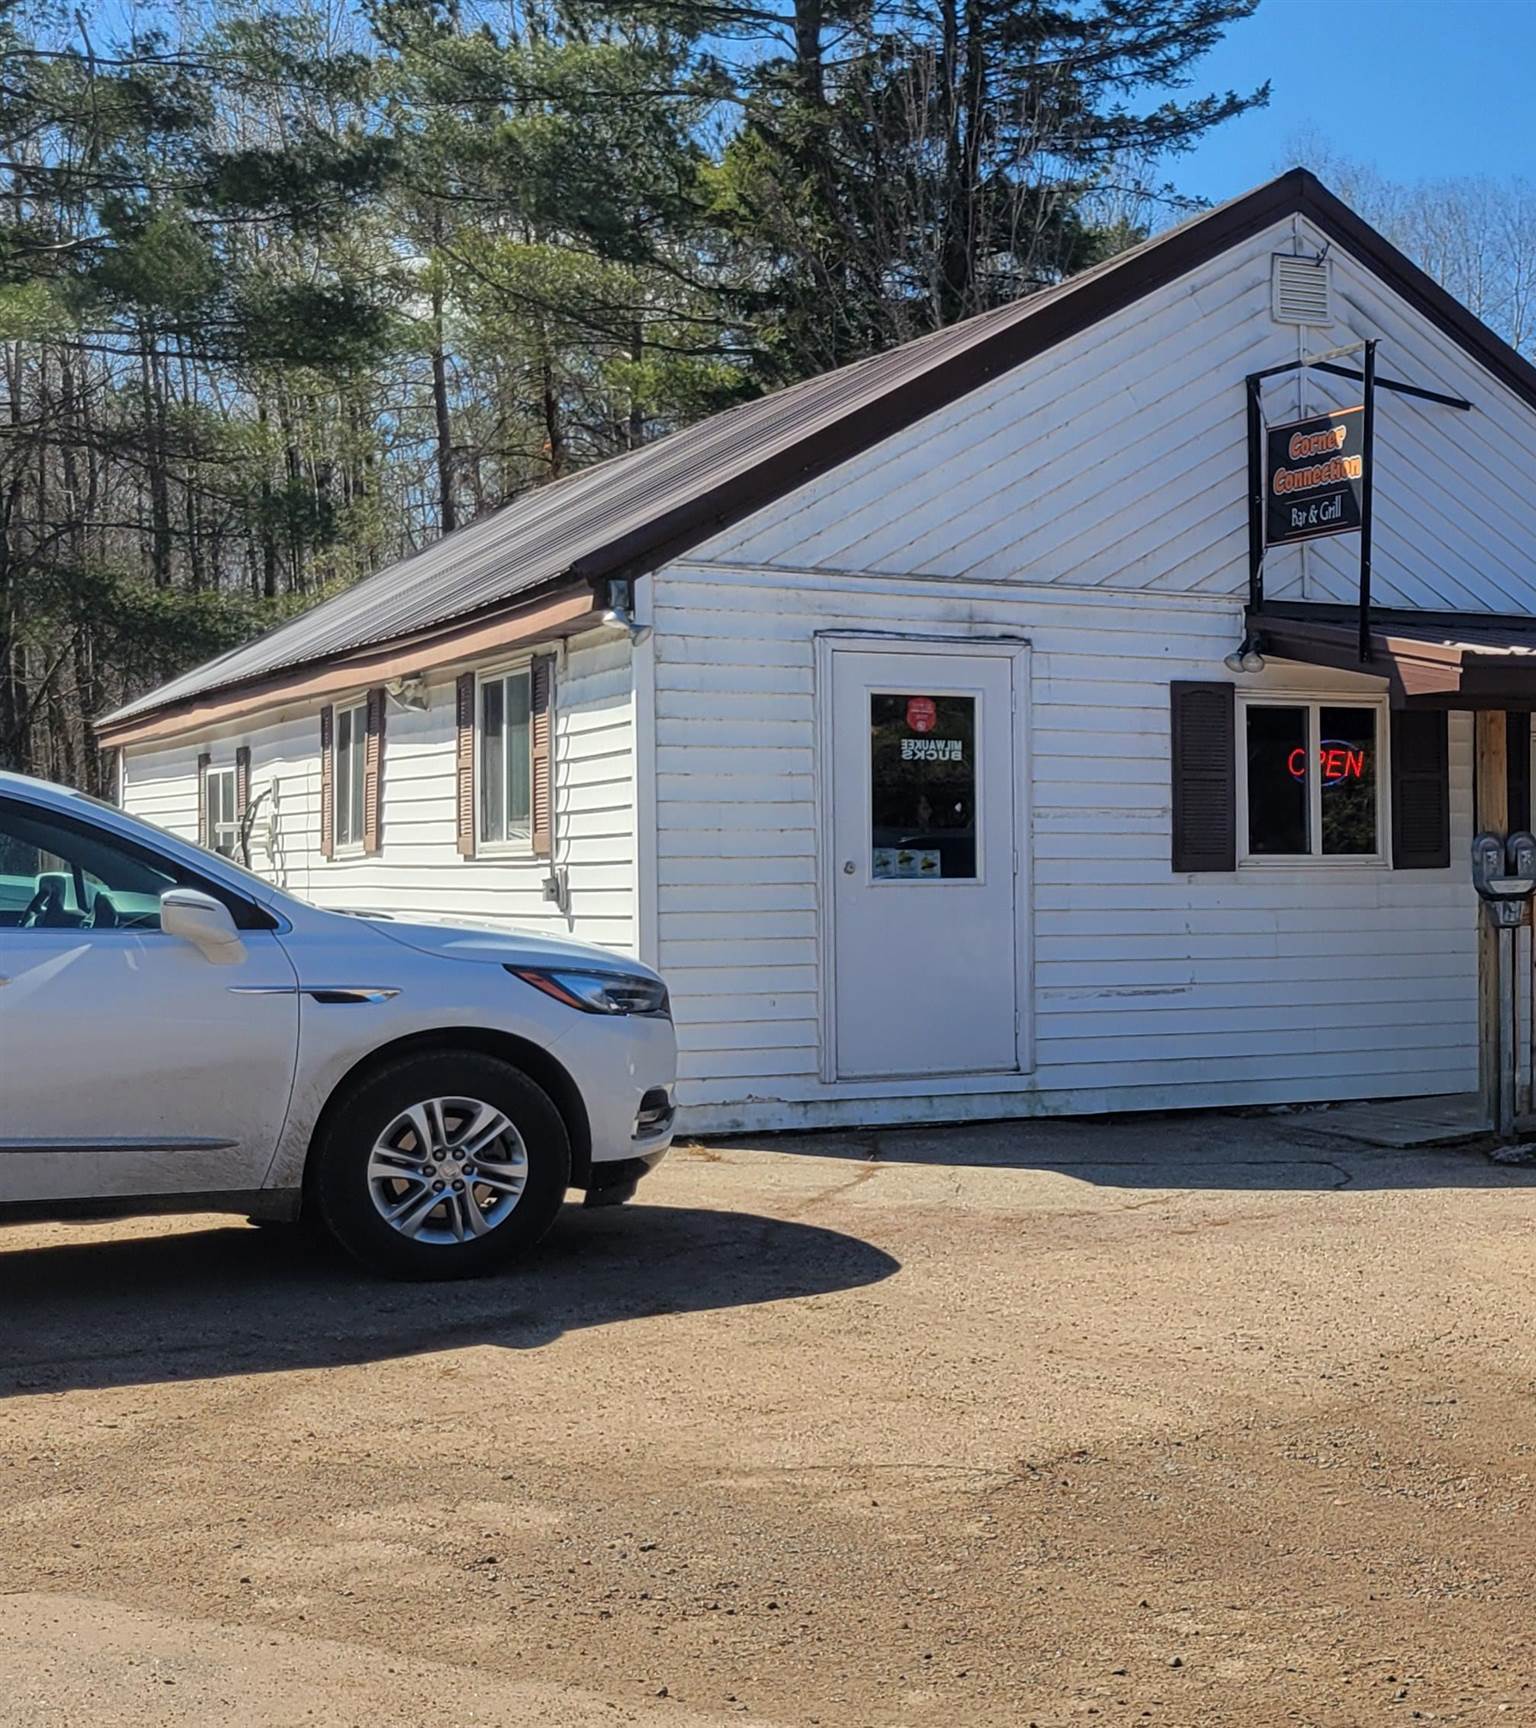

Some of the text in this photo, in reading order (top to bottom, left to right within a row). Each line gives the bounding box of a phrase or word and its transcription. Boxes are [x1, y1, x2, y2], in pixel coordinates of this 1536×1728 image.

[1289, 425, 1346, 460] Corner
[1273, 455, 1362, 495] Connection
[1291, 495, 1342, 527] Bar & Grill
